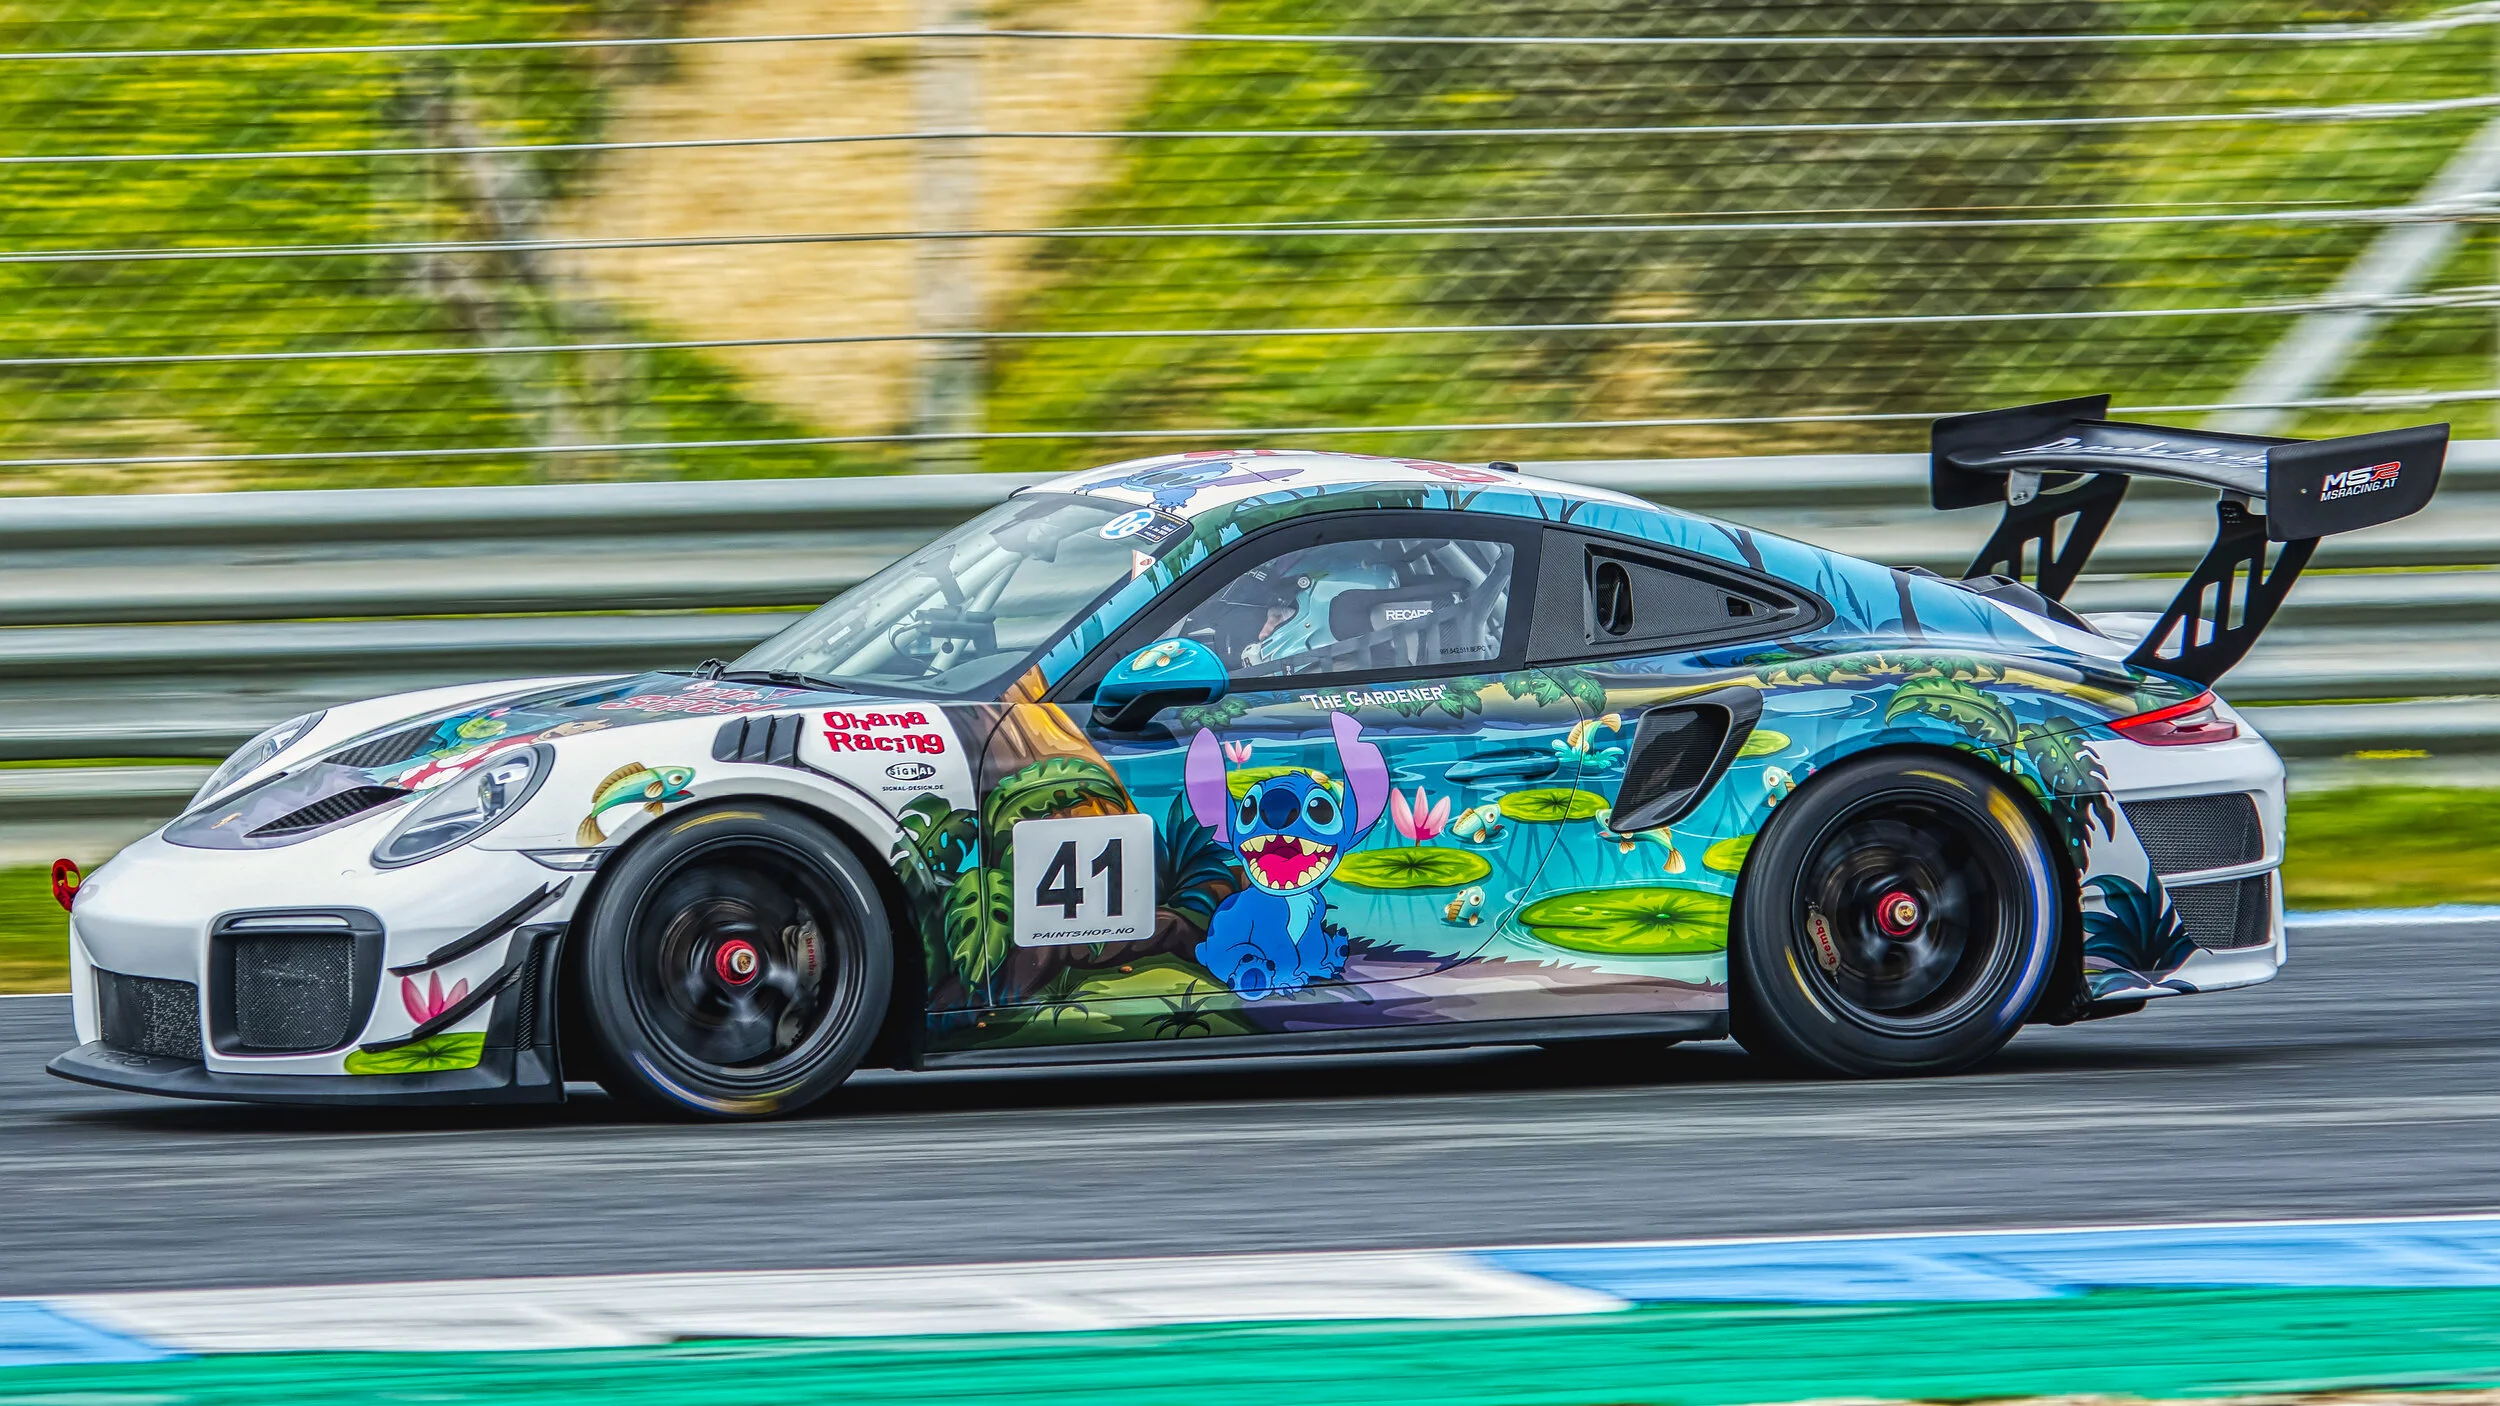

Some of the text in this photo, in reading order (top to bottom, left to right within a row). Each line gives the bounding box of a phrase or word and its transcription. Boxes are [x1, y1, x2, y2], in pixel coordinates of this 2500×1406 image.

[2320, 478, 2398, 502] MSRACING.AT
[1104, 511, 1152, 536] 06
[823, 711, 929, 730] Ohana
[823, 731, 945, 754] Racing
[1036, 838, 1123, 920] 41
[1032, 927, 1135, 940] PAINTSHOP.NO
[1815, 919, 1836, 966] brembo
[806, 938, 817, 977] brembo
